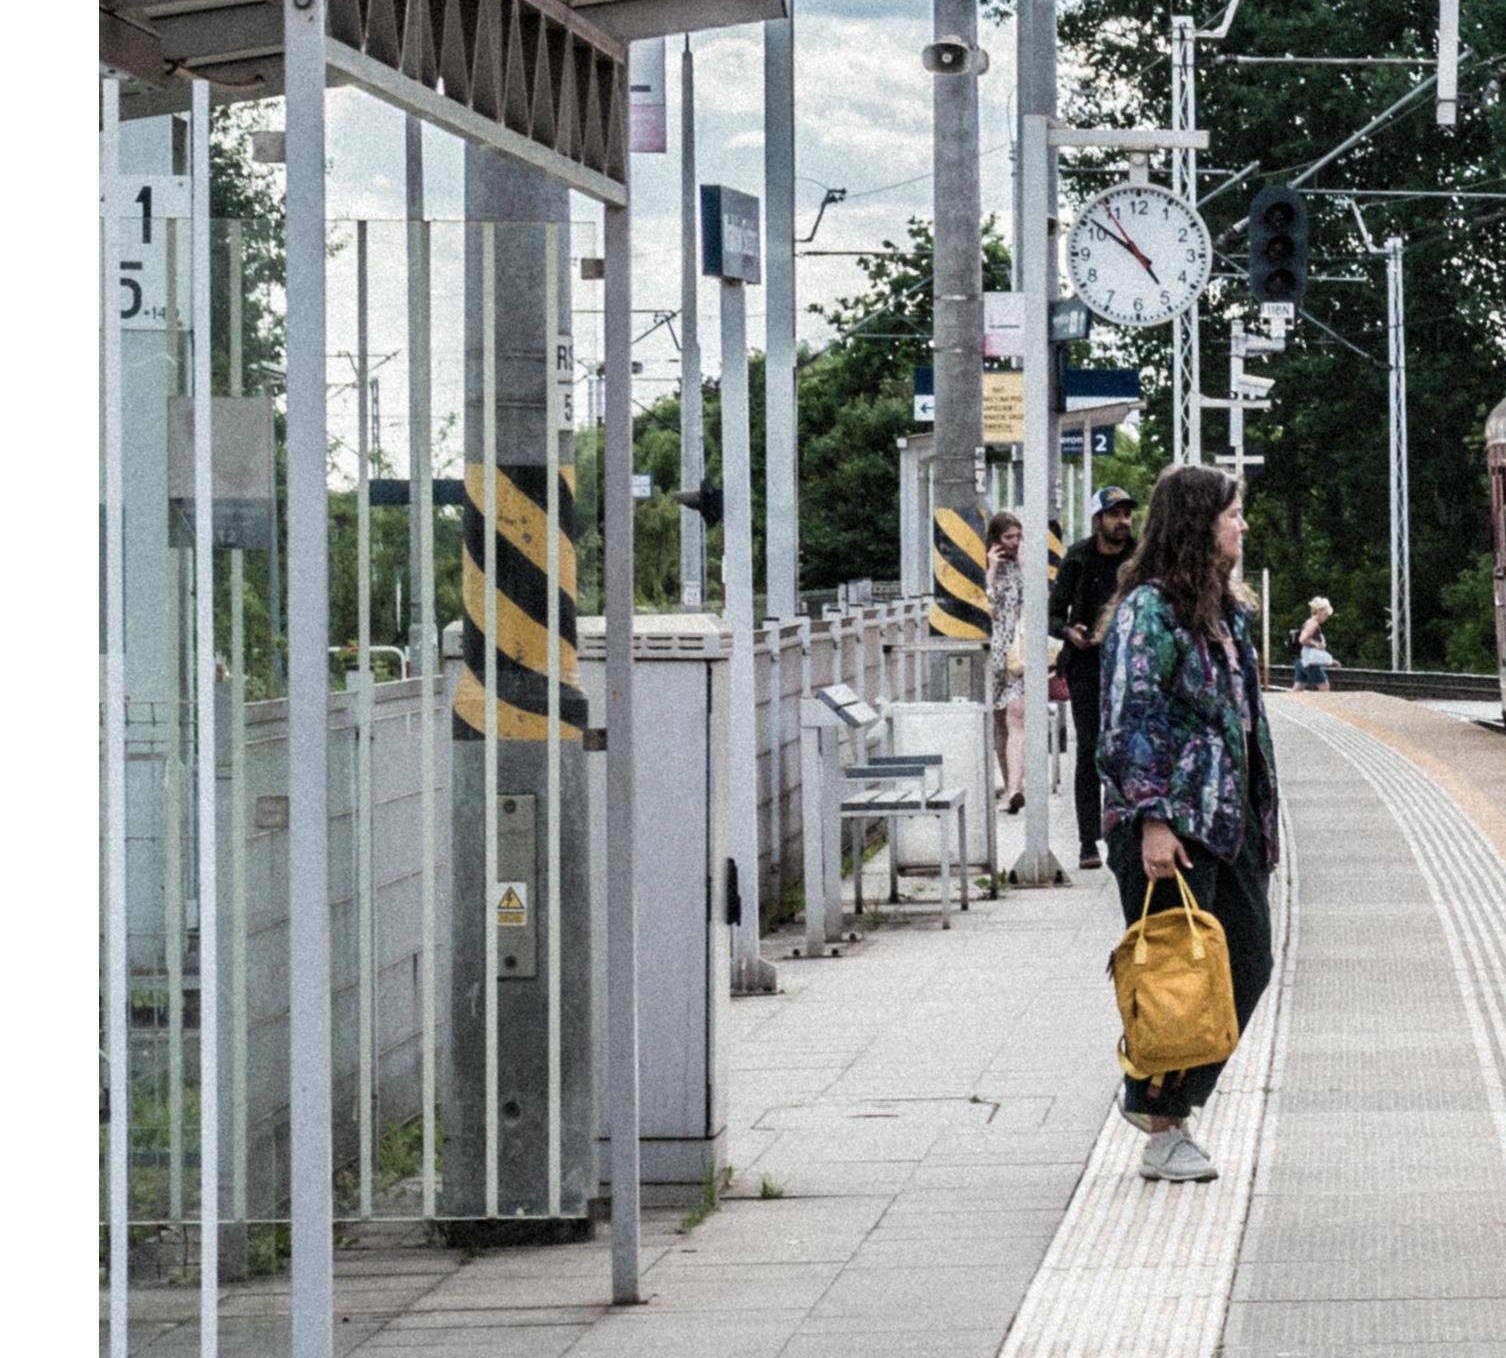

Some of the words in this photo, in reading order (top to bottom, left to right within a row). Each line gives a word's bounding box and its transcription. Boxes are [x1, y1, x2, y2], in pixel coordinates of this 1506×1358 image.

[1130, 200, 1149, 216] 12
[1162, 207, 1169, 221] 1
[1088, 227, 1107, 242] 10
[1178, 228, 1188, 243] 2
[1080, 247, 1091, 261] 9
[1186, 249, 1196, 263] 3
[1087, 268, 1097, 283] 8
[1177, 270, 1187, 283] 4
[1106, 290, 1116, 304] 7
[1160, 291, 1170, 305] 5
[1133, 298, 1143, 312] 6
[1095, 434, 1108, 452] 2
